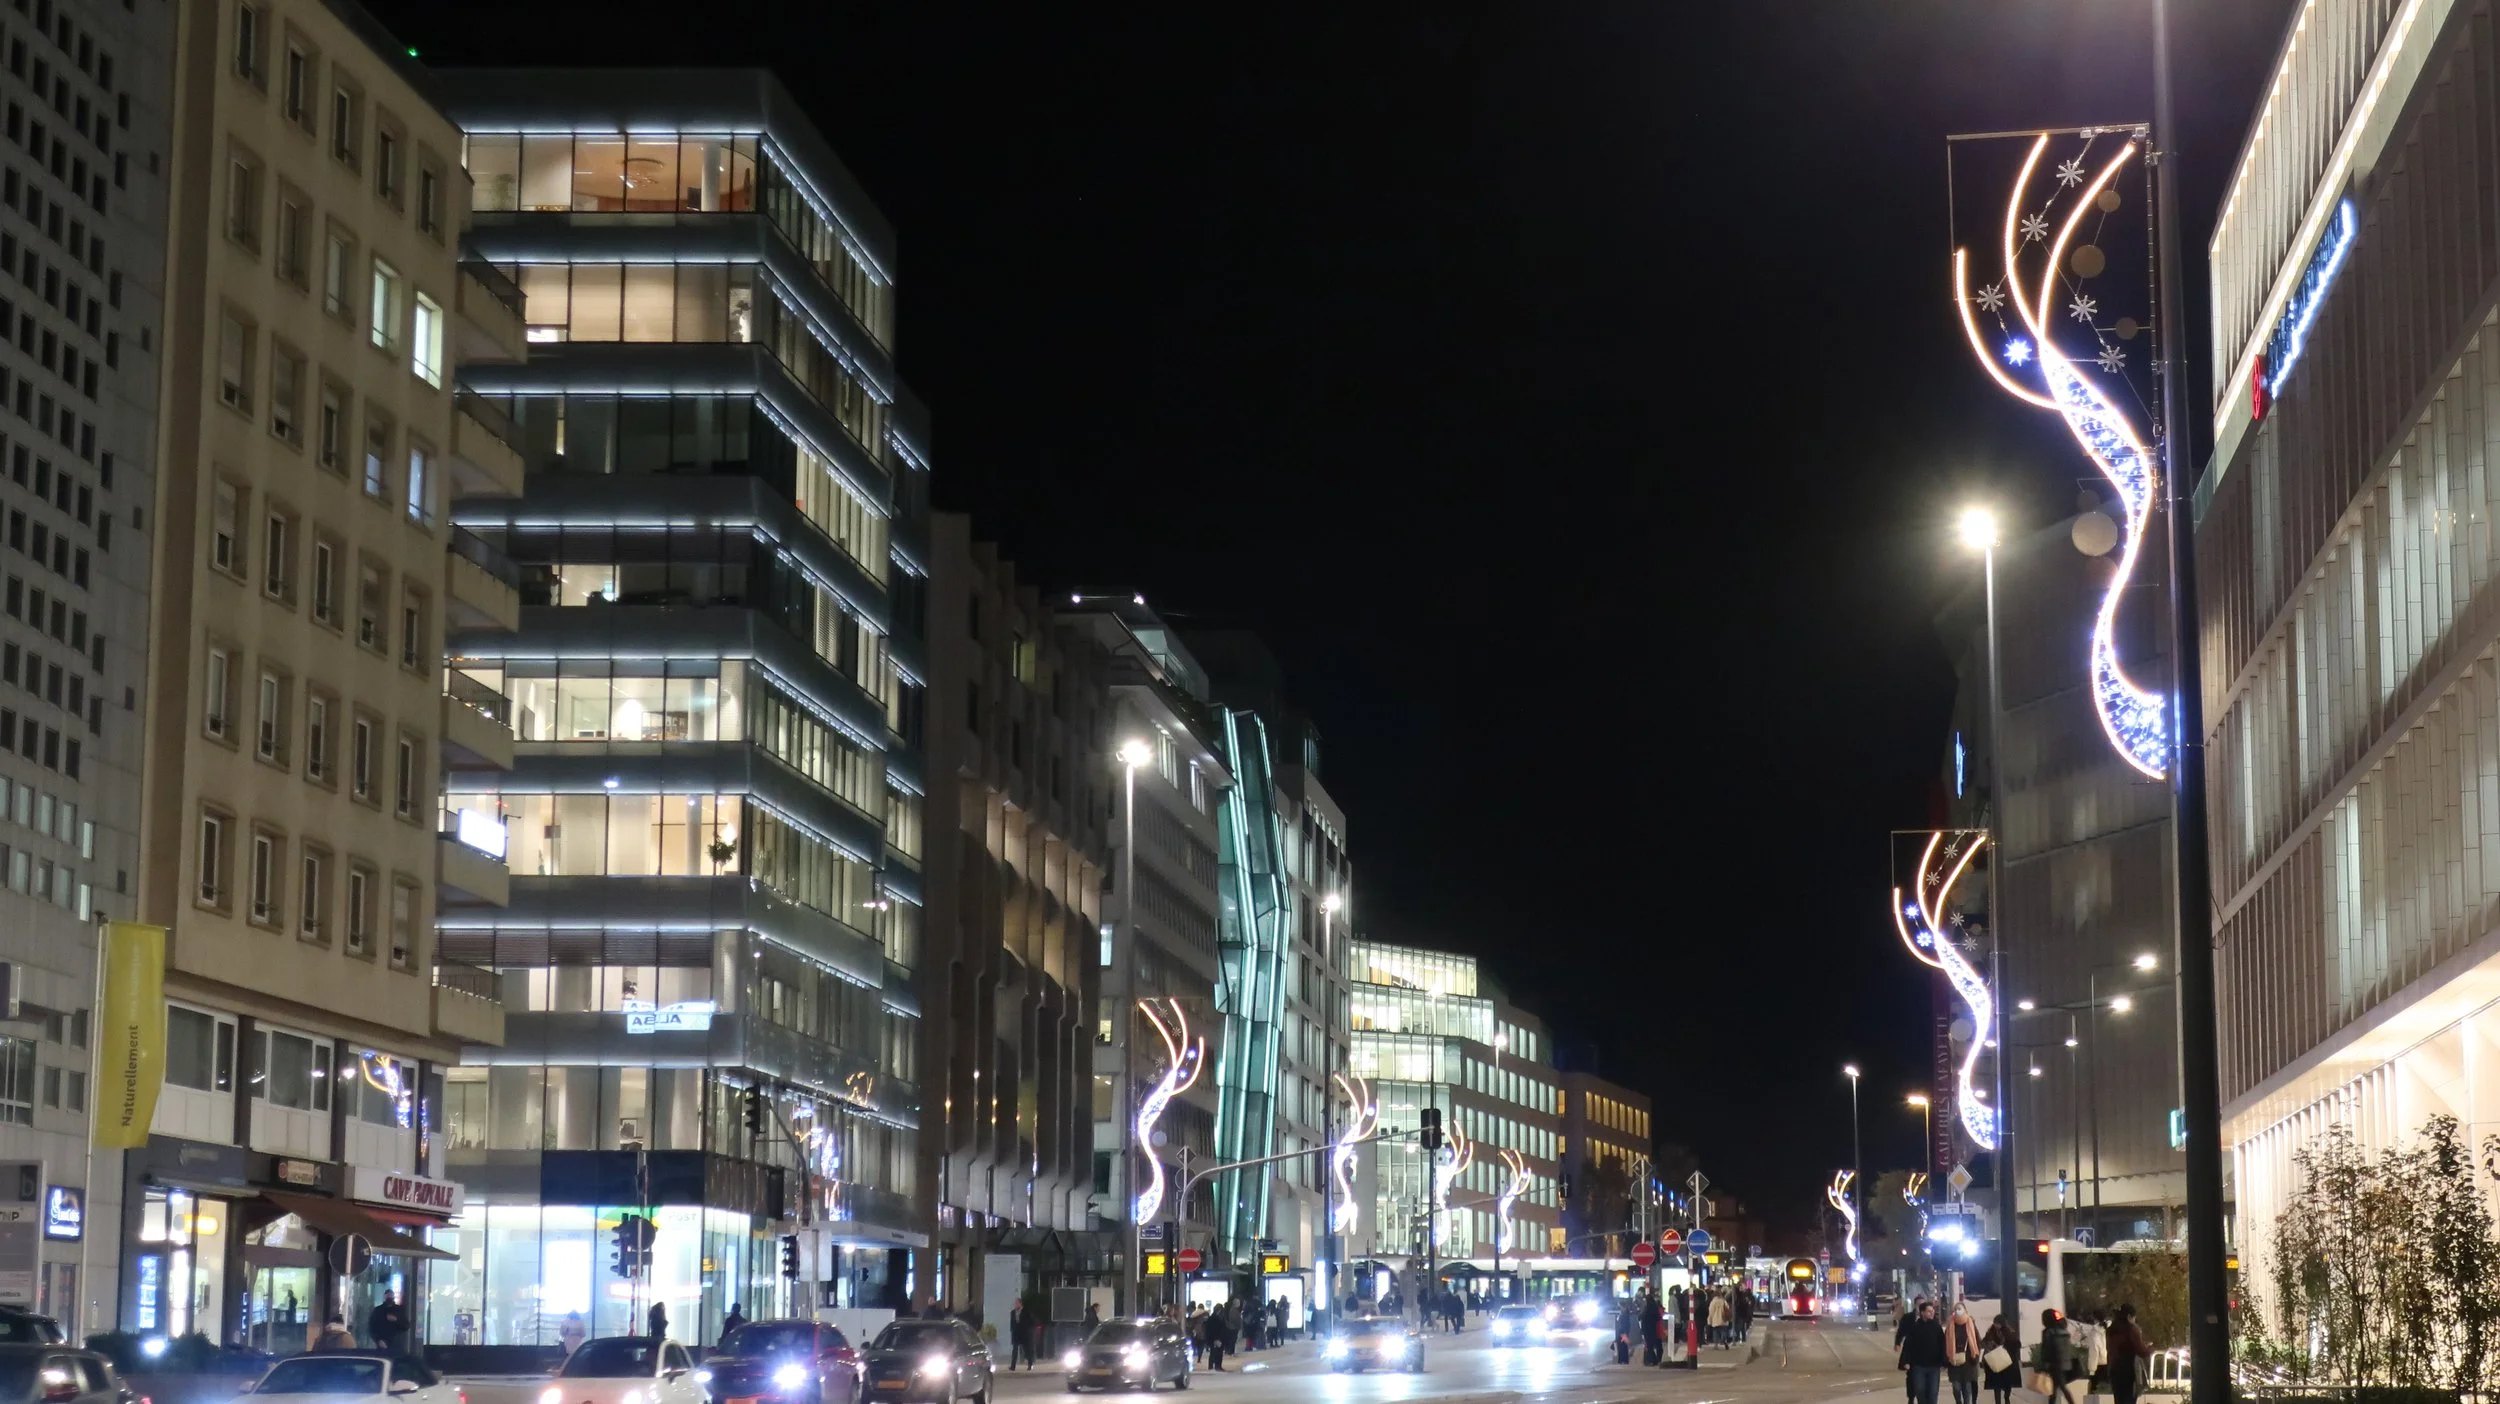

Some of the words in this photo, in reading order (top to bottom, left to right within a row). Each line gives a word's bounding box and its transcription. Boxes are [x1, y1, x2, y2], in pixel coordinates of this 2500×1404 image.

[121, 1025, 139, 1127] Naturellement
[1936, 1014, 1948, 1092] LAFAYETTE
[1938, 1097, 1949, 1166] GALERIES
[384, 1176, 411, 1201] CAVE
[414, 1181, 454, 1208] ROYALE
[668, 1212, 697, 1222] POST
